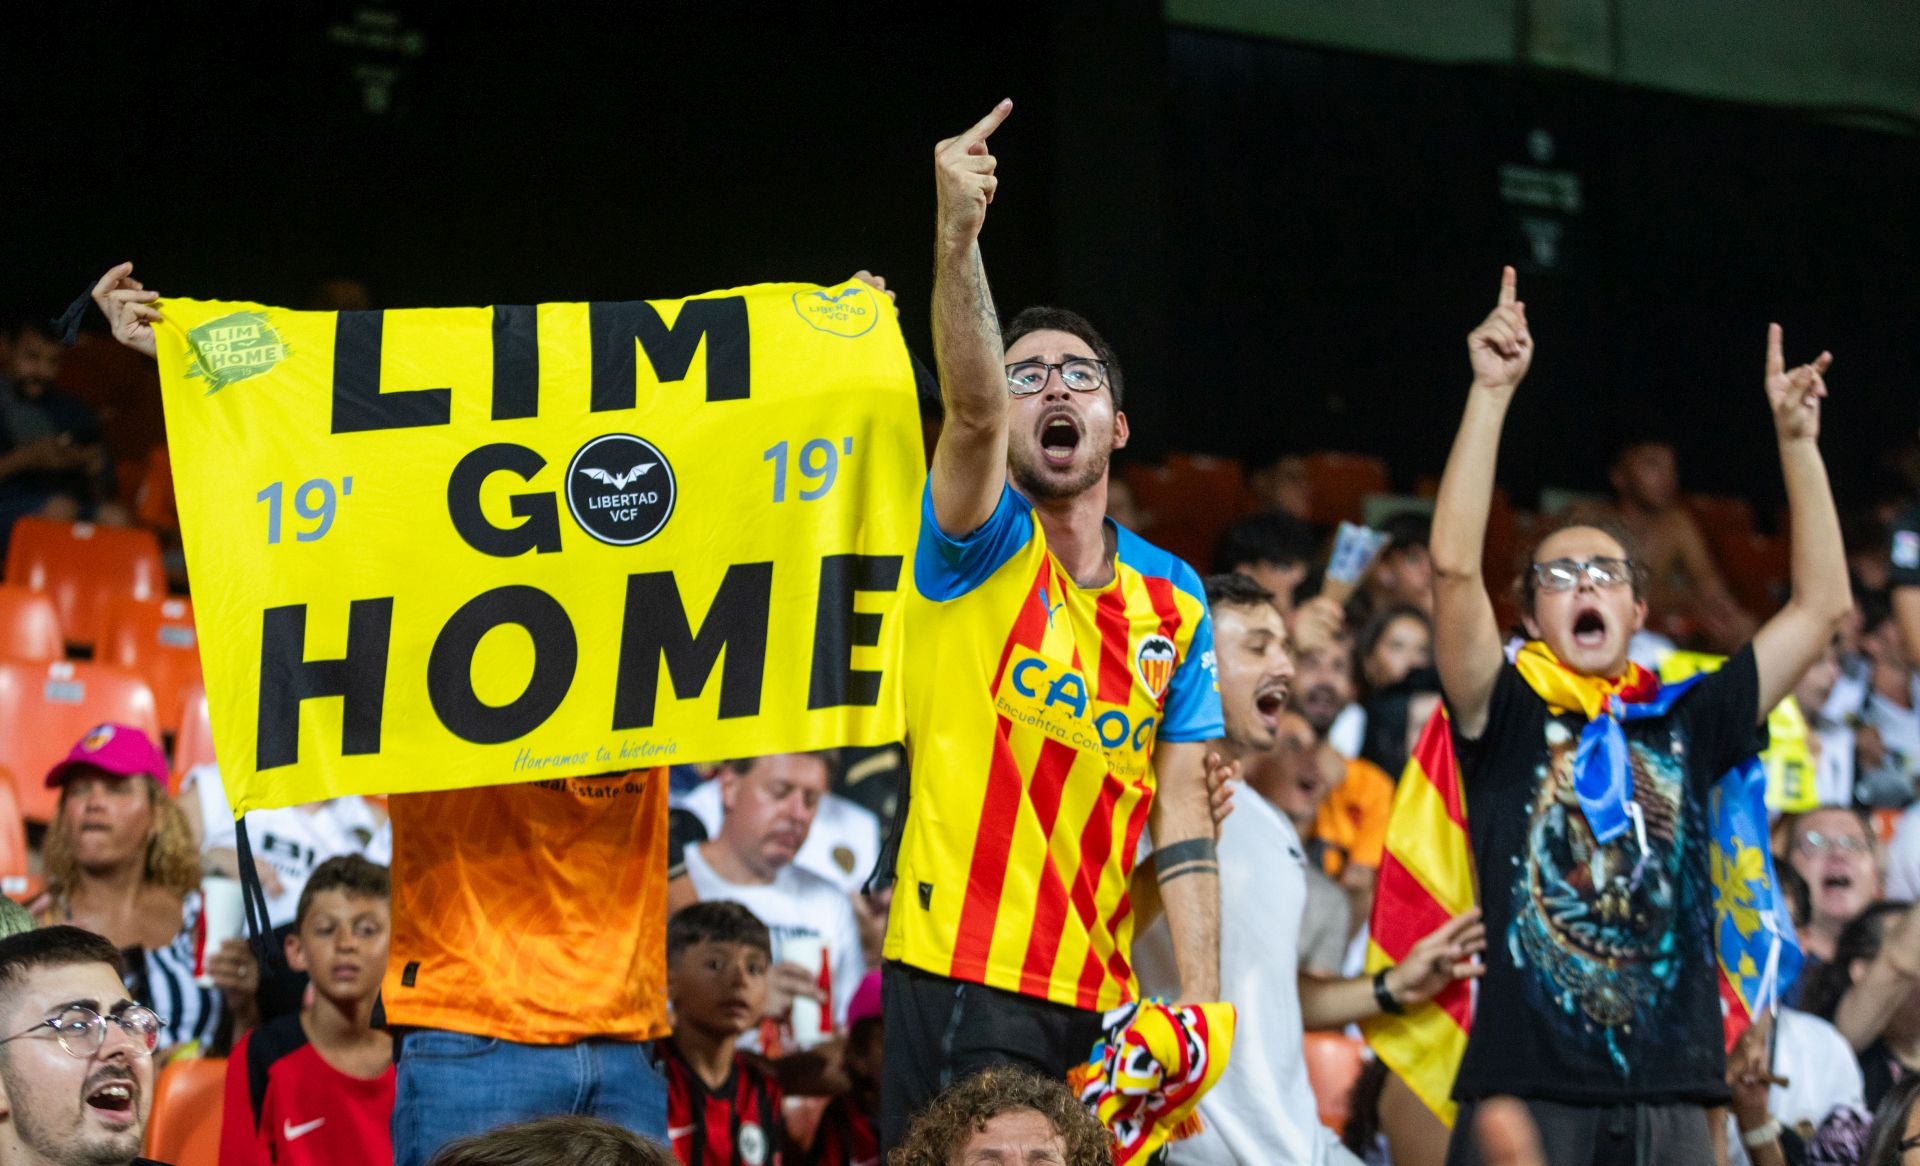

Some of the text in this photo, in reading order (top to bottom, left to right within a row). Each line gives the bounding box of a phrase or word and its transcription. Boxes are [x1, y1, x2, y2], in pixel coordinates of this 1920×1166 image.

[809, 304, 866, 315] LIBERTAD
[215, 327, 253, 341] LIM
[202, 342, 228, 353] GO
[211, 347, 277, 370] HOME
[331, 296, 750, 434] LIM
[763, 436, 853, 503] 19'
[256, 476, 353, 544] 19'
[588, 491, 658, 509] LIBERTAD
[610, 508, 638, 522] VCF
[256, 553, 903, 772] HOME
[513, 747, 588, 772] Honramos
[619, 739, 677, 759] historia
